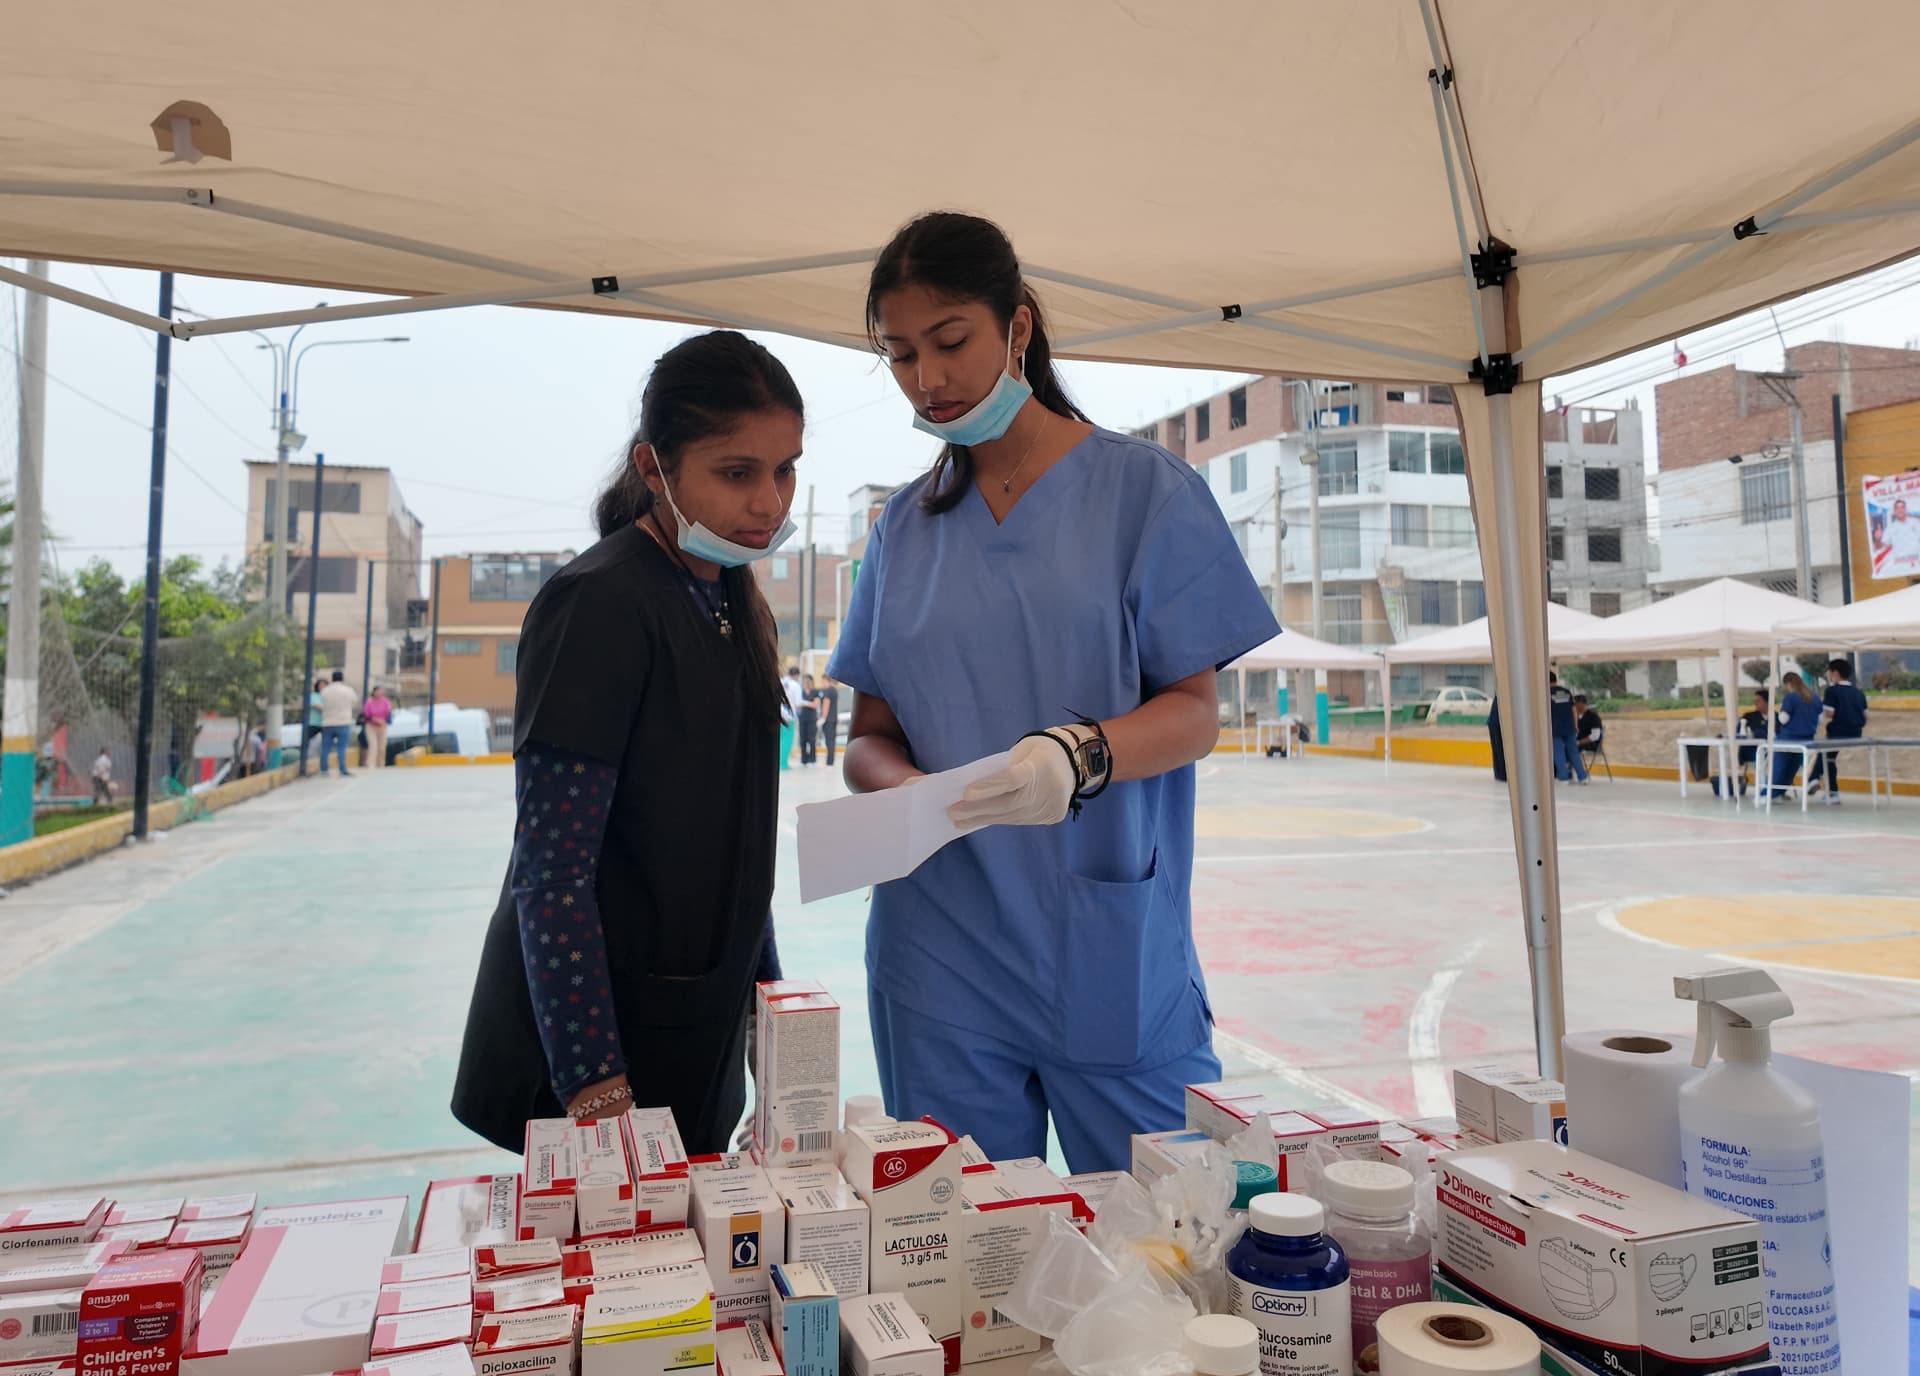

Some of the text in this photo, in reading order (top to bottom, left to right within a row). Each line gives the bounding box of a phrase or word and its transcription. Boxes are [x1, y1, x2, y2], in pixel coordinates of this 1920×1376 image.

[1332, 1131, 1379, 1144] Paracetamol
[1278, 1142, 1309, 1152] Paracet
[887, 1160, 903, 1172] AC
[1702, 1151, 1731, 1166] Alcohol
[1702, 1164, 1723, 1178] Agua
[1724, 1170, 1767, 1185] Destilada
[640, 1184, 677, 1192] Diclofenaco
[1452, 1175, 1494, 1210] Dimerc
[1571, 1176, 1631, 1199] Dimerc
[525, 1201, 562, 1209] Diclofenaco
[1703, 1186, 1778, 1210] INDICACIONES:
[264, 1209, 384, 1226] Complejo B
[1475, 1209, 1517, 1238] Desechable
[1775, 1213, 1808, 1224] estados
[2, 1236, 80, 1250] Clorfenamina
[575, 1231, 685, 1251] Doxiciclina
[884, 1233, 949, 1253] LACTULOSA
[901, 1249, 949, 1267] 3,3 g/5 mL
[576, 1263, 693, 1285] Doxiciclina
[1351, 1285, 1377, 1299] atal
[1381, 1286, 1392, 1300] &
[1396, 1282, 1423, 1299] DHA
[87, 1293, 131, 1305] amazon
[716, 1294, 770, 1309] BUPROFEN
[1254, 1295, 1304, 1312] Option+
[1661, 1305, 1685, 1316] pliegues
[1771, 1305, 1815, 1316] OLCCASA
[134, 1317, 161, 1325] Compare
[1768, 1319, 1825, 1332] lizabeth Rojas
[83, 1347, 166, 1366] Children's
[1260, 1343, 1298, 1360] ulfate
[481, 1355, 557, 1374] Dicloxacilina
[1604, 1350, 1618, 1369] 50
[118, 1366, 128, 1376] &
[131, 1361, 173, 1376] Fever
[1302, 1364, 1317, 1372] joint
[1317, 1363, 1330, 1371] pain
[1781, 1365, 1820, 1375] ALEJADO
